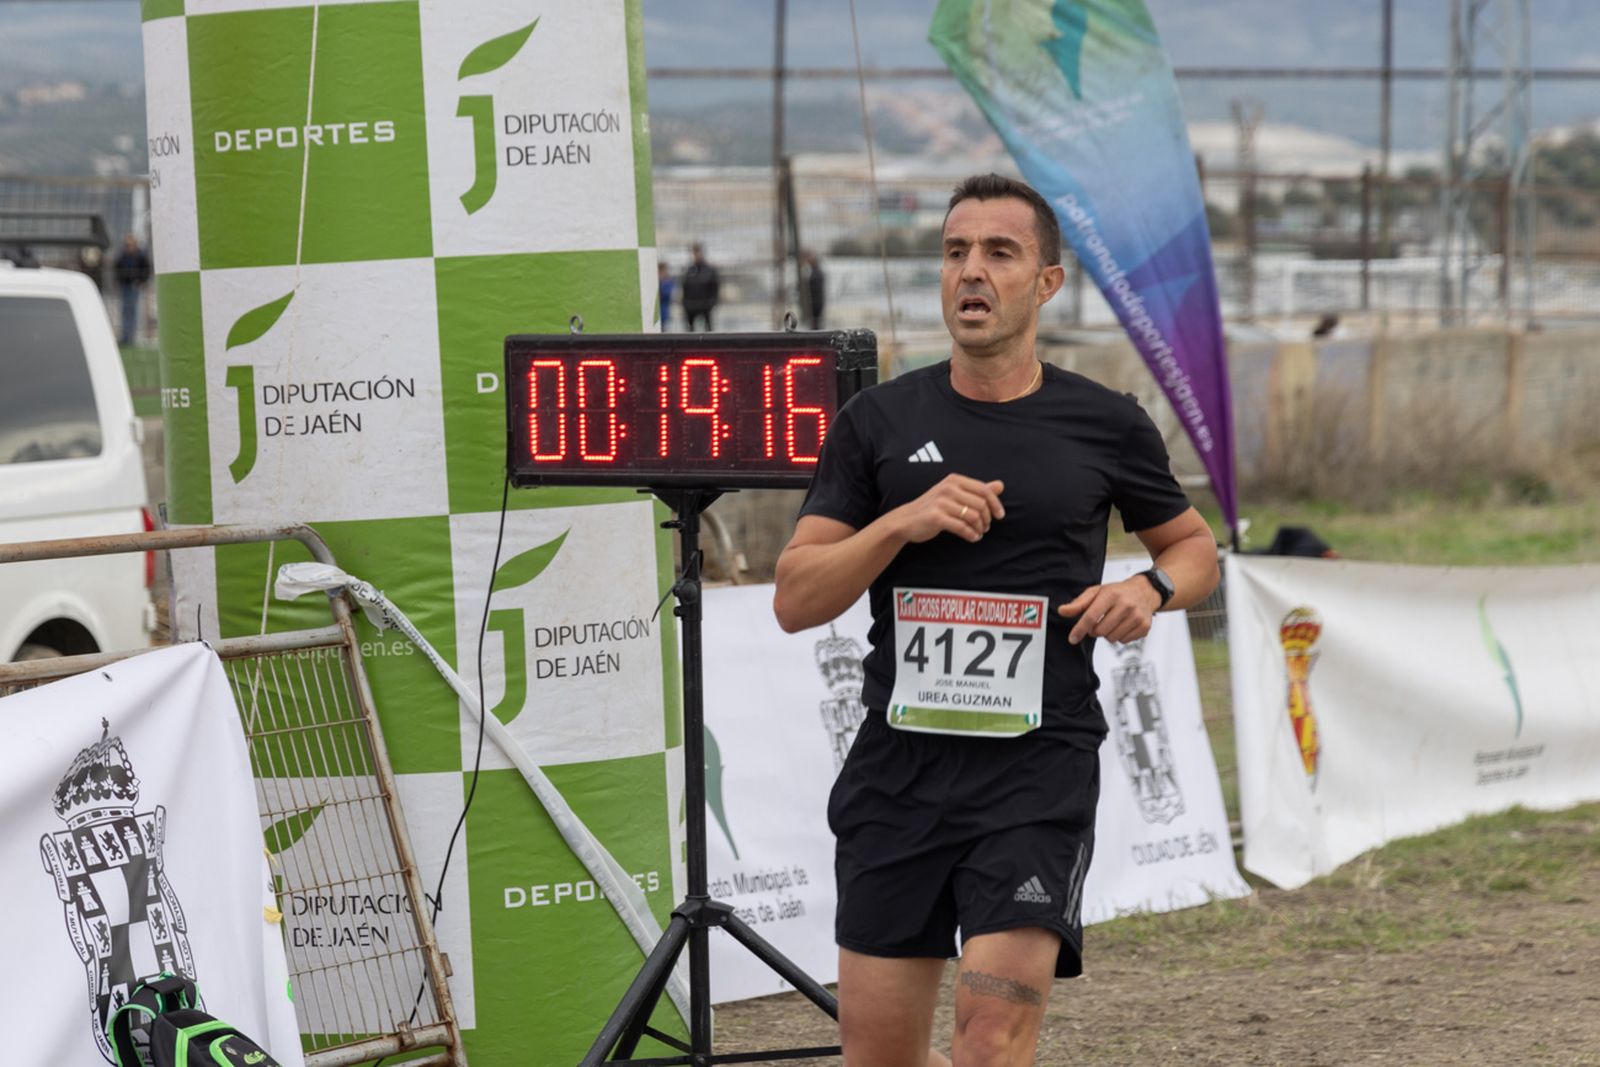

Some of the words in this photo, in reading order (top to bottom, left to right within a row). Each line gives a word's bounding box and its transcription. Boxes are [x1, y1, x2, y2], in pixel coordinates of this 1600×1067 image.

[504, 108, 620, 136] DIPUTACIÓN
[214, 120, 396, 153] DEPORTES
[505, 145, 538, 167] DE
[542, 140, 591, 166] JAÉN
[262, 375, 415, 405] DIPUTACIÓN
[265, 415, 294, 437] DE
[299, 410, 363, 435] JAÉN
[917, 597, 940, 619] CROSS
[940, 598, 977, 621] POPULAR
[977, 600, 1007, 623] CIUDAD
[1006, 602, 1020, 625] DE
[534, 616, 651, 648] DIPUTACIÓN
[536, 657, 567, 680] DE
[571, 650, 621, 676] JAÉN
[904, 625, 1033, 679] 4127
[935, 678, 954, 689] JOSE
[956, 680, 992, 690] MANUEL
[917, 691, 951, 704] UREA
[952, 692, 1013, 708] GUZMAN
[732, 867, 793, 896] Municipal
[793, 864, 809, 886] de
[758, 901, 775, 923] de
[293, 926, 323, 948] DE
